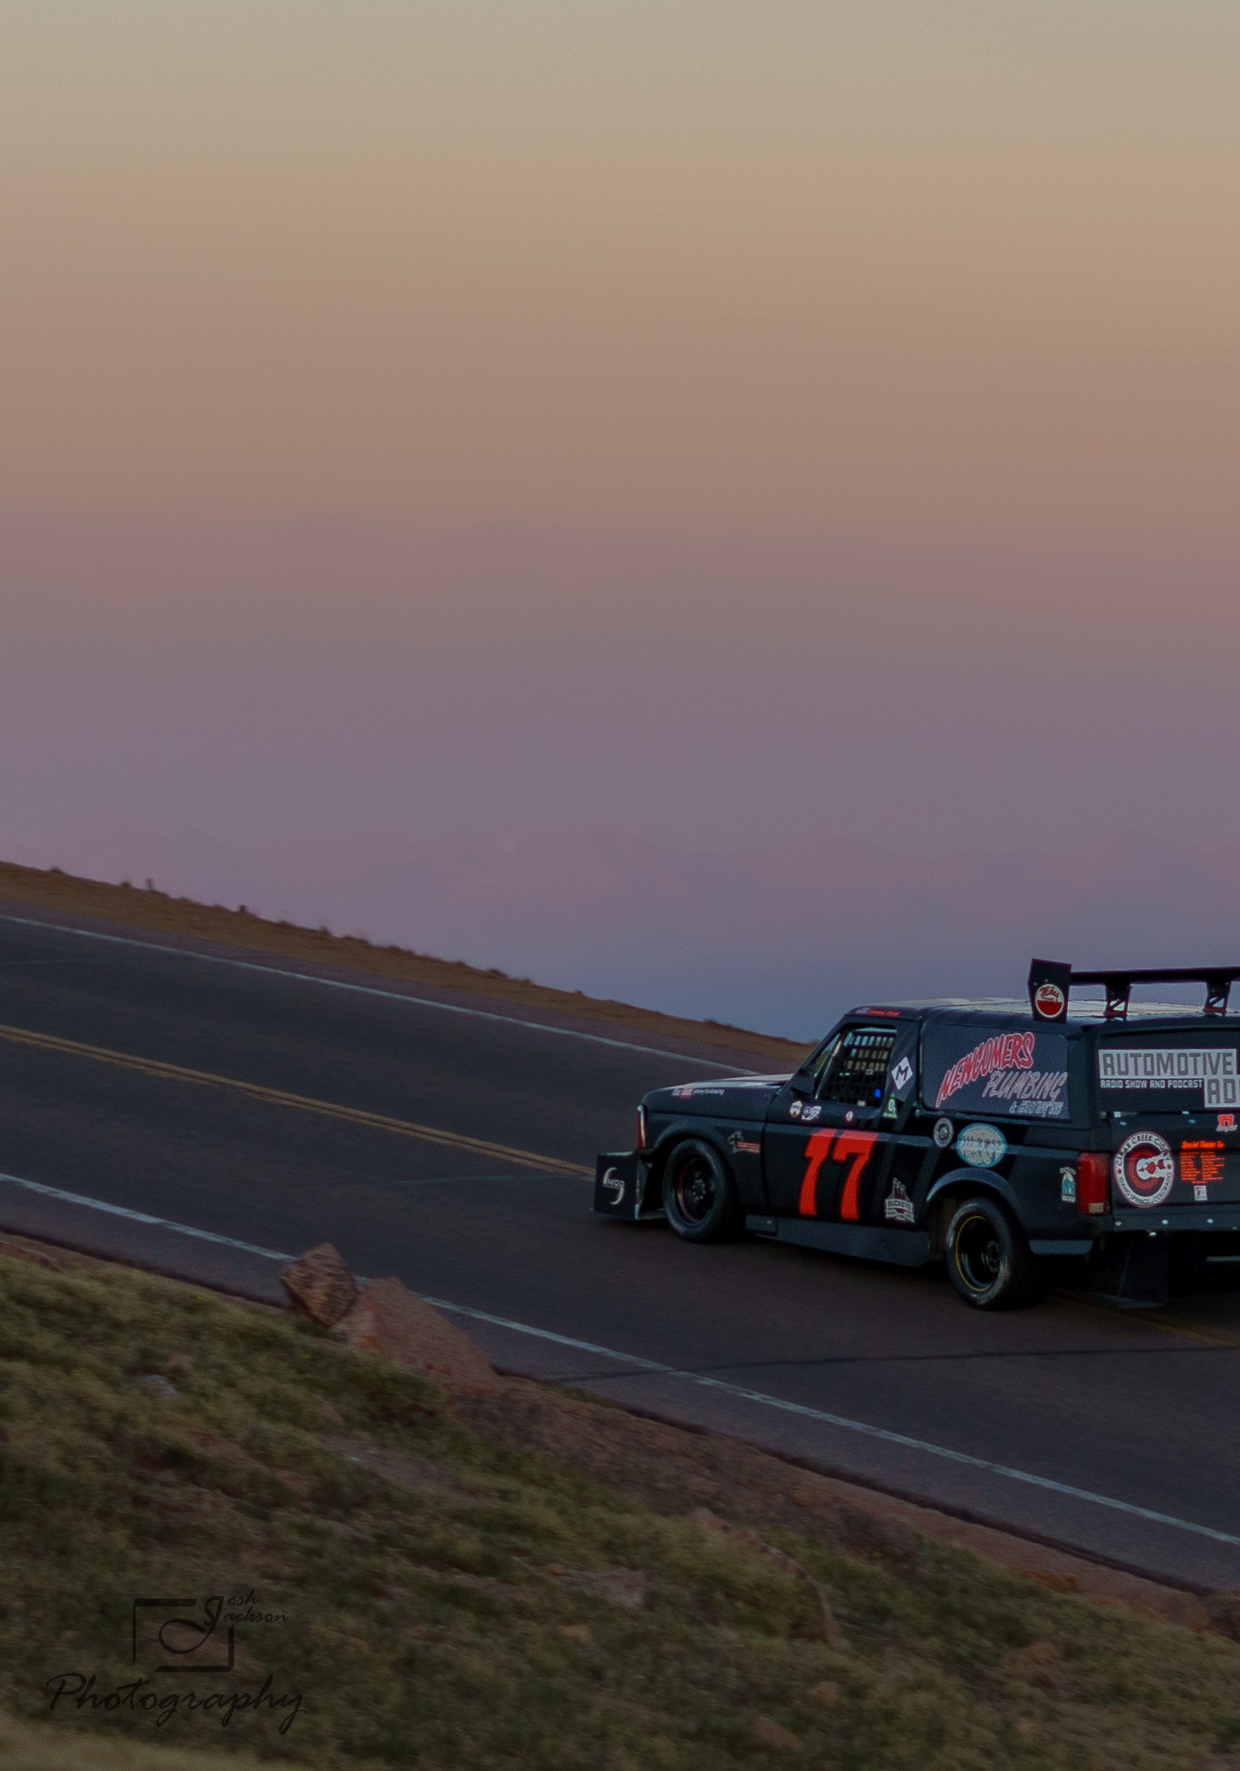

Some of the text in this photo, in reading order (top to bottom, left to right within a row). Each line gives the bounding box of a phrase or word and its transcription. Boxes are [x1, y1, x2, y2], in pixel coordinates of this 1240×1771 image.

[935, 1031, 1035, 1108] NEWCOMERS
[1102, 1053, 1233, 1076] AUTOMOTIVE
[982, 1070, 1068, 1103] PLUMBING
[1100, 1079, 1203, 1089] RADIO SHOW AND PODCAST
[1131, 1134, 1153, 1144] CREEK
[798, 1128, 880, 1220] 17
